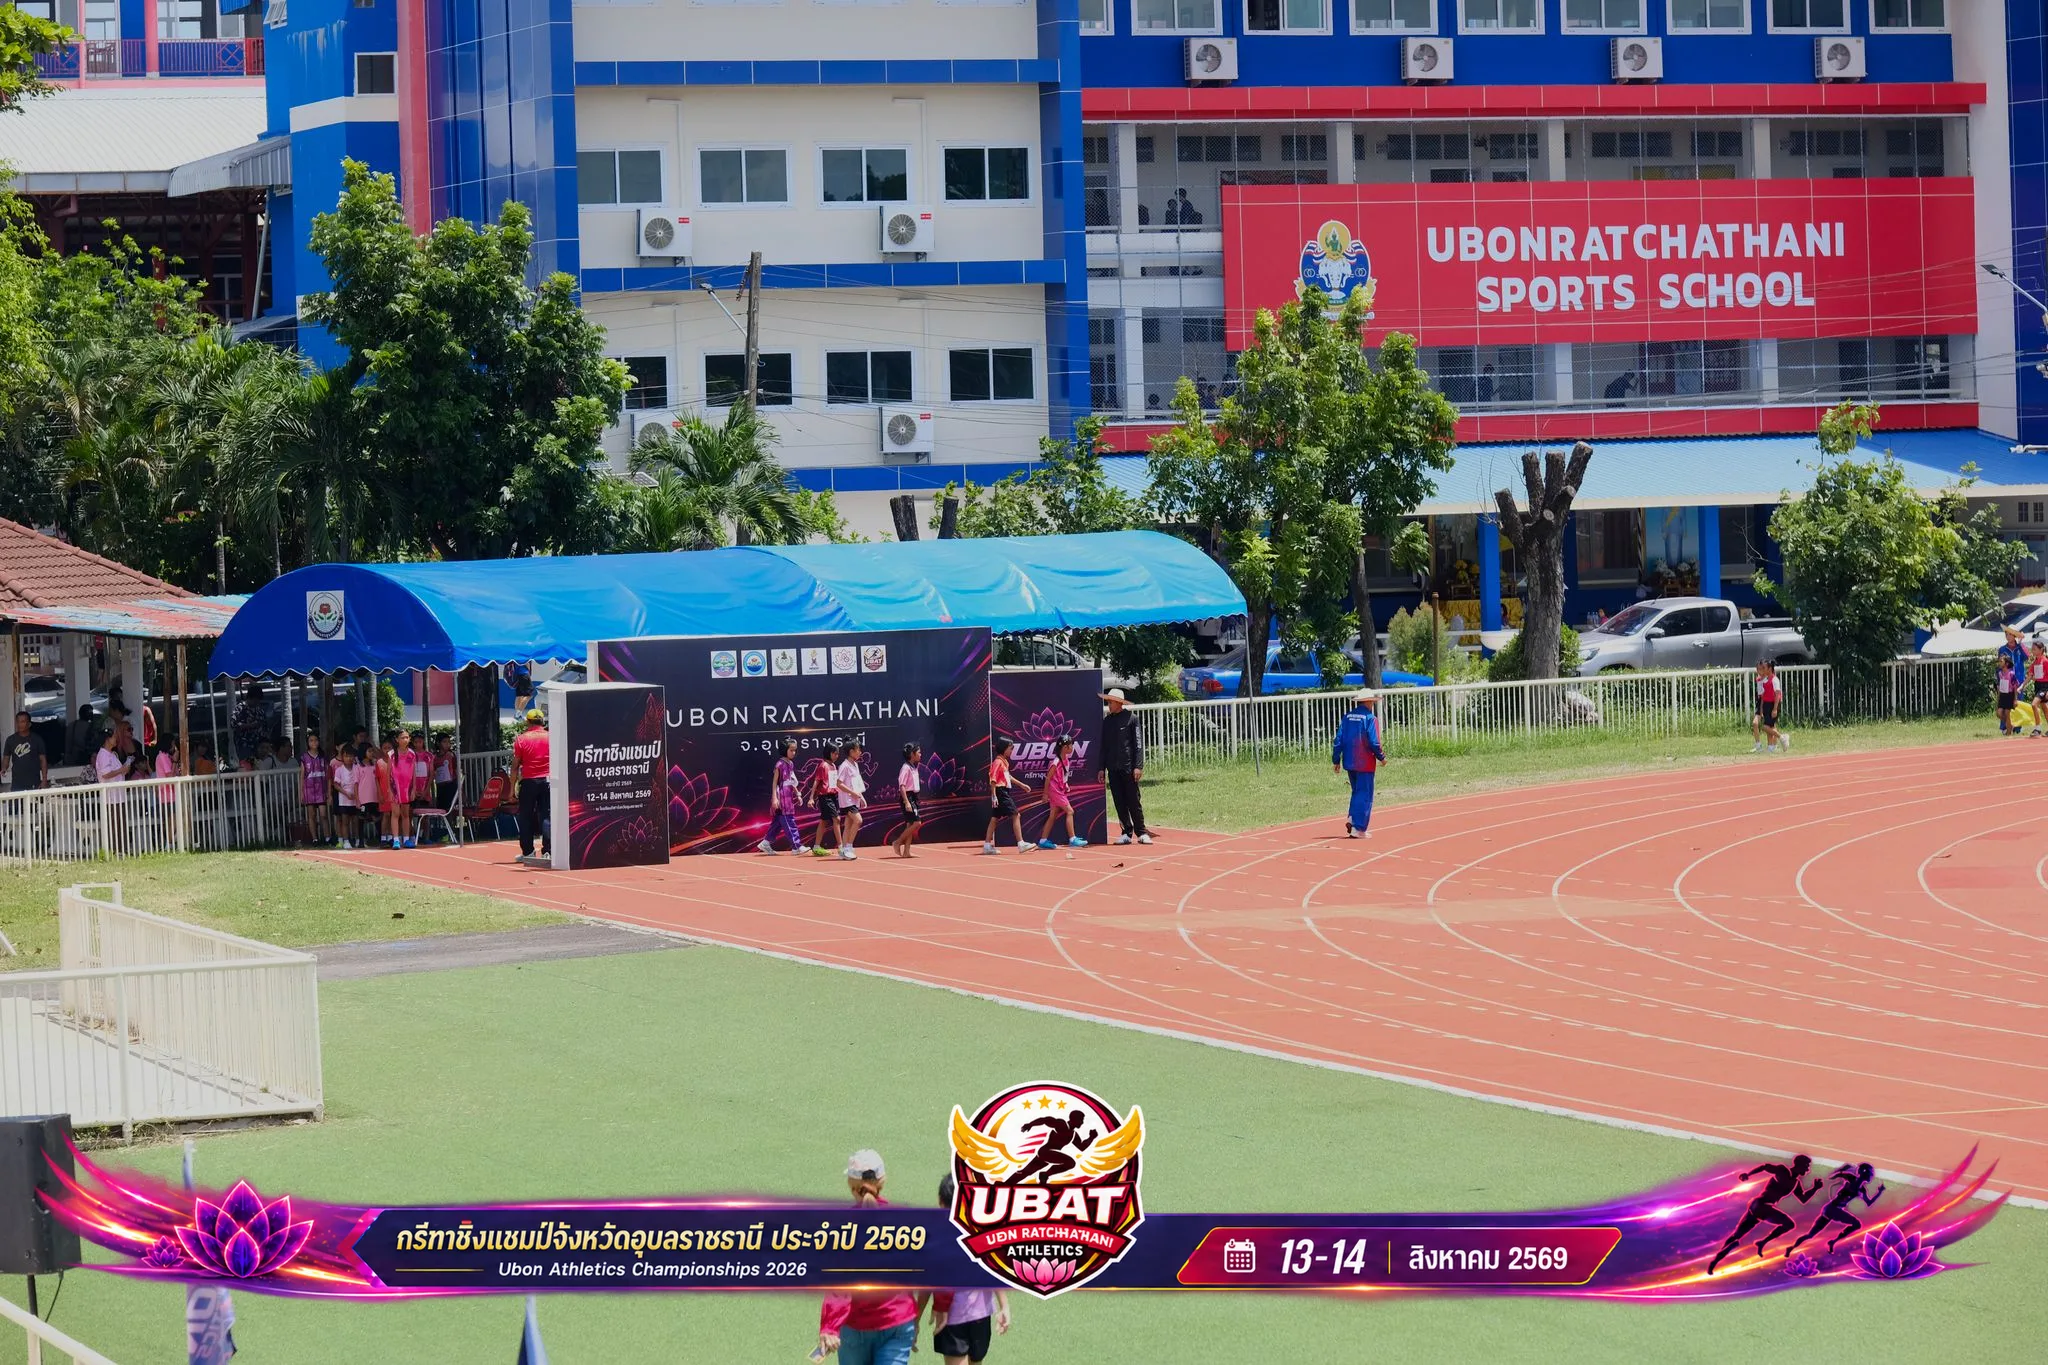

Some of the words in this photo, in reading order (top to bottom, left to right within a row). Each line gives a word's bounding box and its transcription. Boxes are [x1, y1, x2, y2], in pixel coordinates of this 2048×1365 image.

[1427, 222, 1846, 263] UBONRATCHATHANI
[1477, 274, 1636, 313] SPORTS
[1658, 271, 1817, 310] SCHOOL
[666, 706, 748, 727] UBON
[763, 698, 940, 724] RATCHATHANI
[635, 790, 652, 798] 2569
